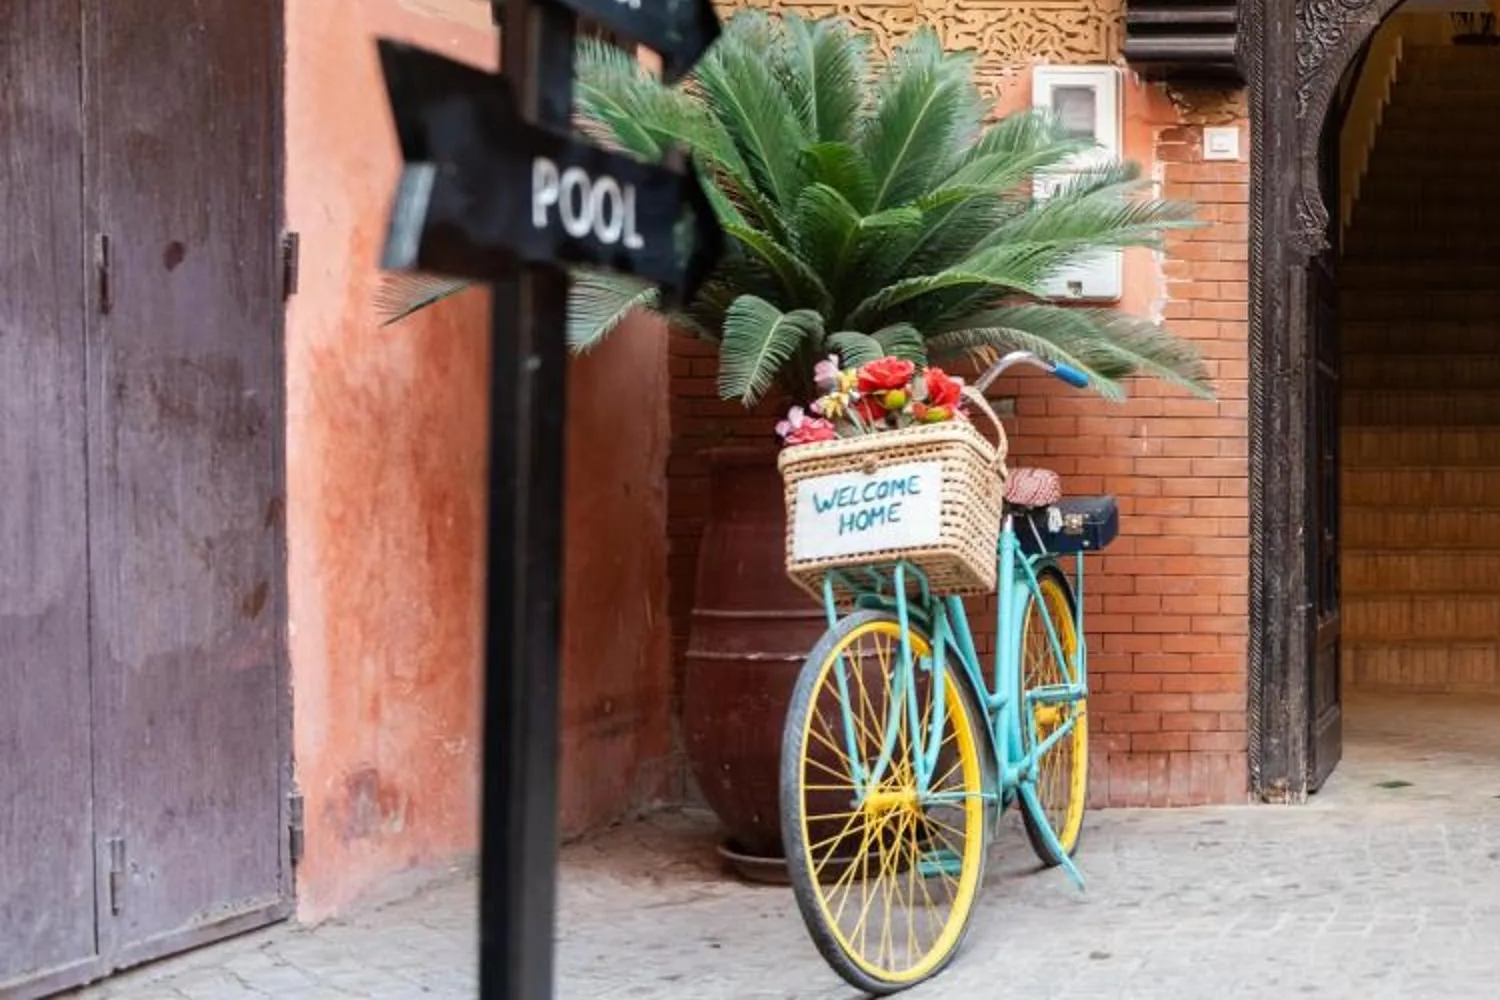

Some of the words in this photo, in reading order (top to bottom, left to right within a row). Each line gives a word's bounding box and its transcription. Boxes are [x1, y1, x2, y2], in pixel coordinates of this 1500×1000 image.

[531, 156, 645, 250] POOL
[813, 474, 922, 515] WELCOME
[838, 503, 903, 536] HOME
